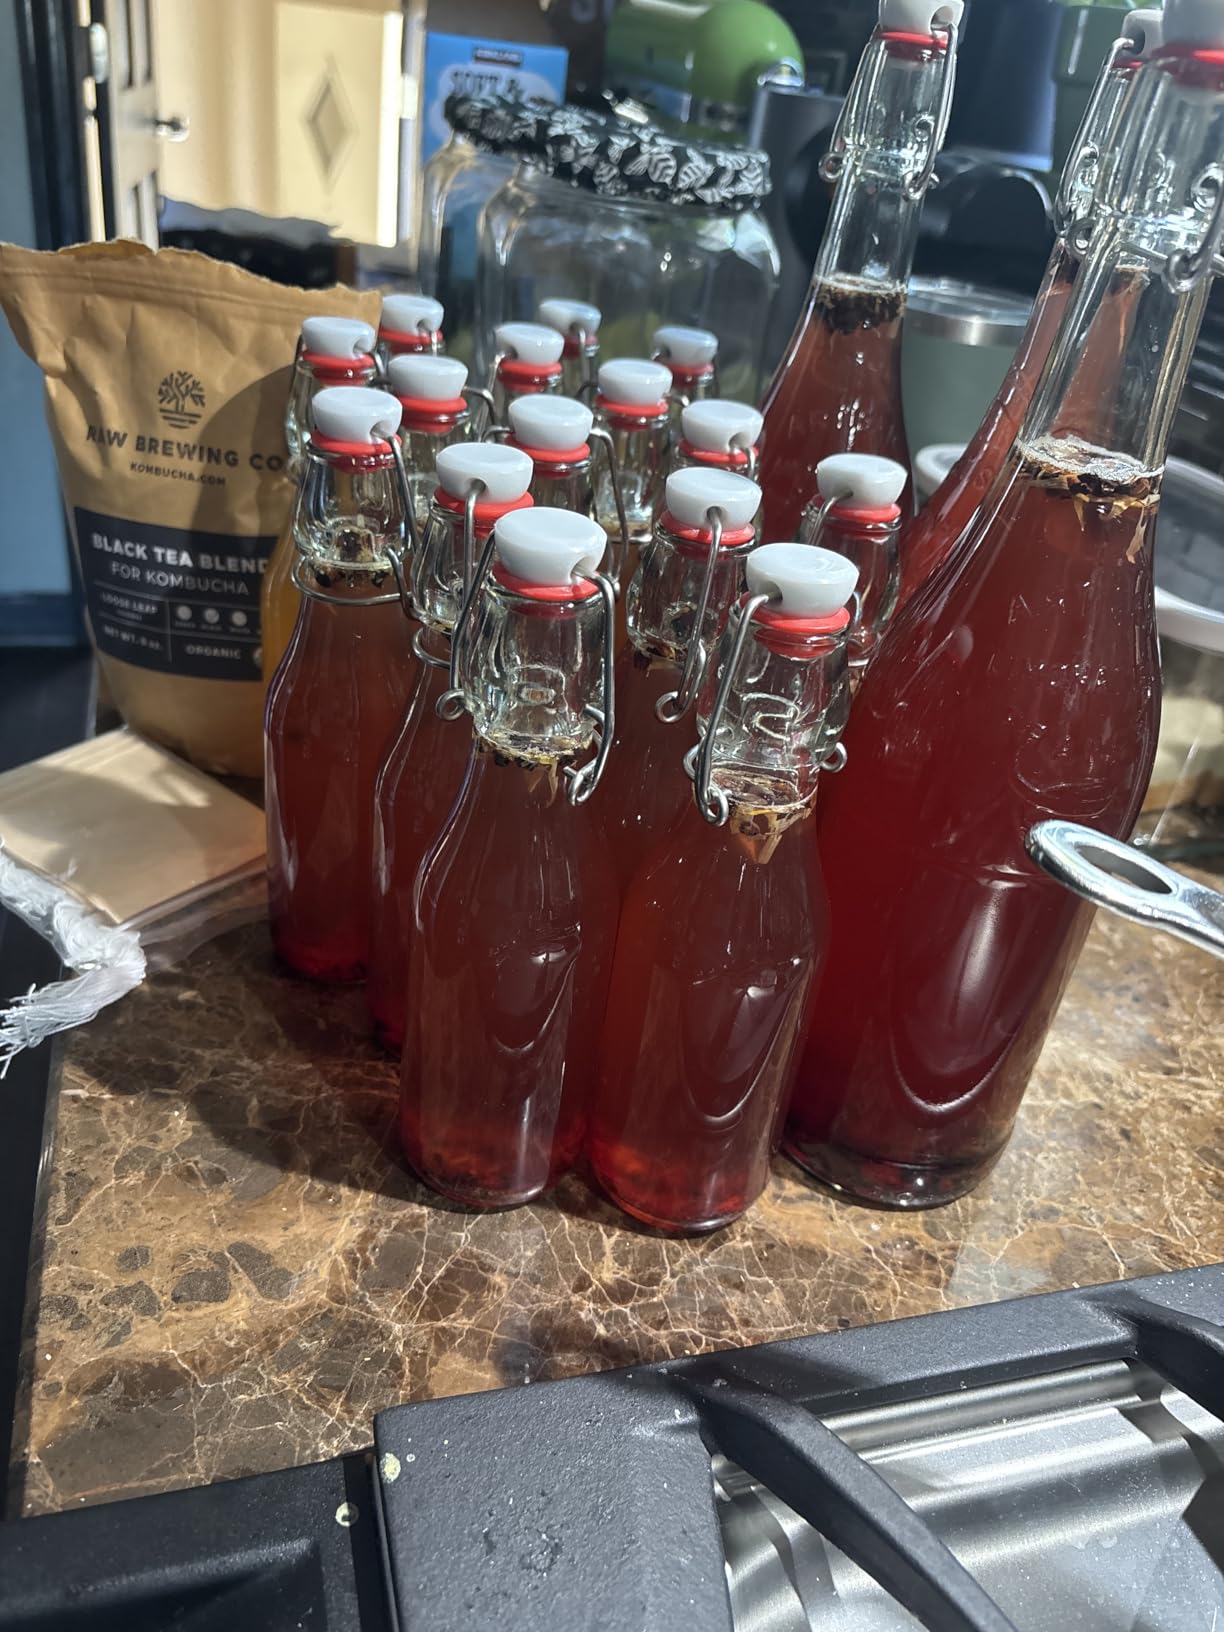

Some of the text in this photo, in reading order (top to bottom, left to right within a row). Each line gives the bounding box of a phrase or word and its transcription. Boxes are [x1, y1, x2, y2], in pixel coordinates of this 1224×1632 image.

[87, 426, 127, 447] RAW
[136, 436, 238, 467] BREWING
[131, 463, 225, 486] KOMBUCHA.COM
[92, 533, 148, 560] BLACK
[153, 545, 193, 568] TEA
[111, 561, 249, 595] FOR KOMBUCHA
[186, 645, 241, 659] ORGANIC
